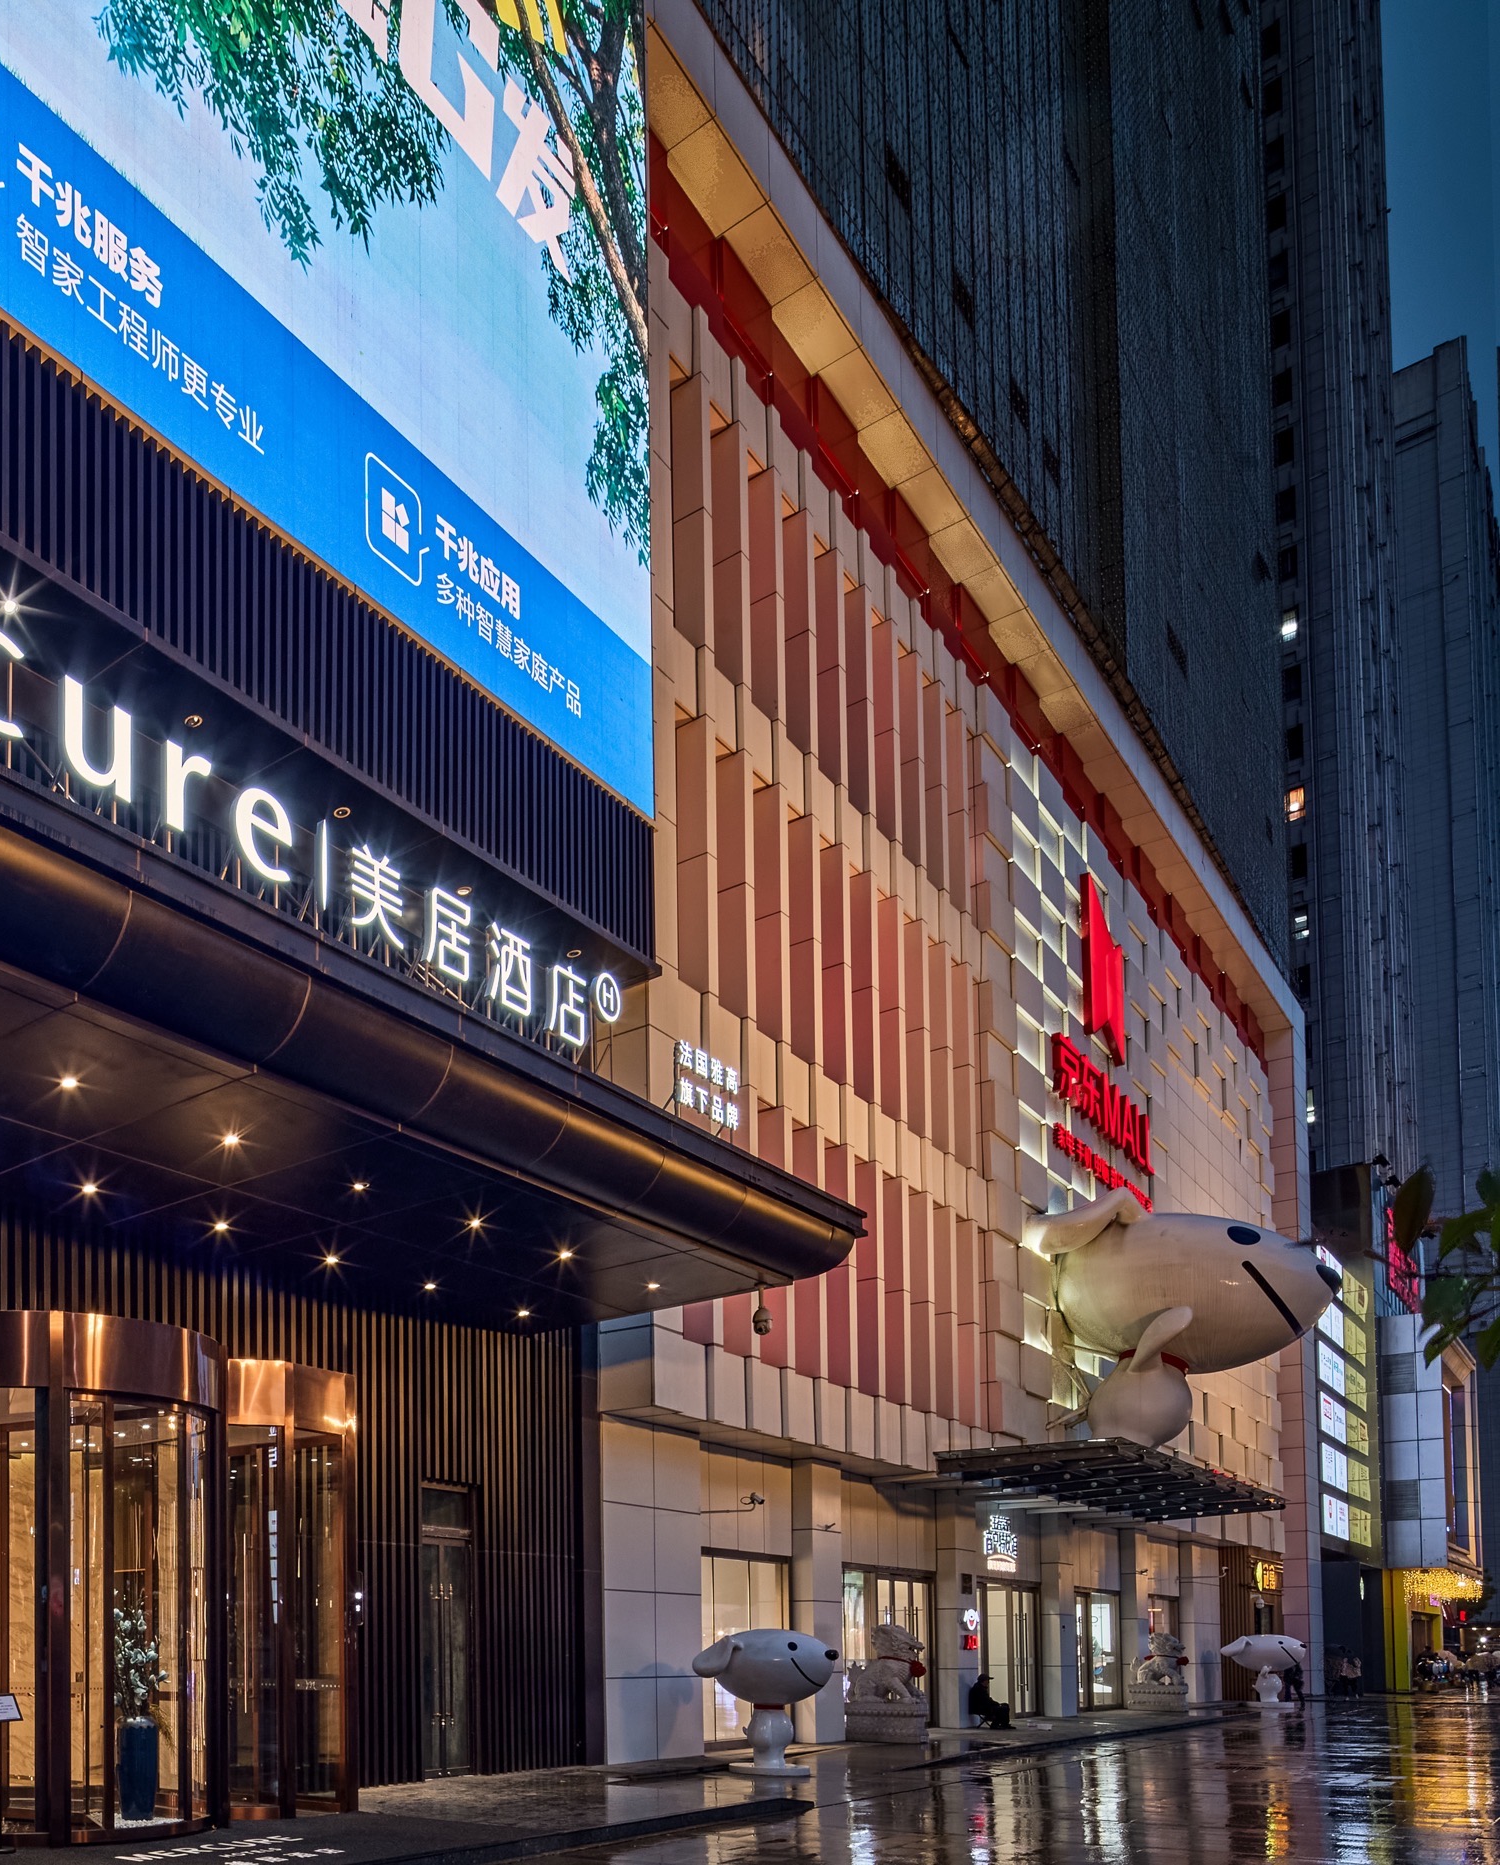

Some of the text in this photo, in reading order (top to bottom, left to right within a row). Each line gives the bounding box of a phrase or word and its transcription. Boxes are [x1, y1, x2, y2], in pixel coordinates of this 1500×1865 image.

[16, 143, 163, 309] 千兆服务
[16, 213, 266, 457] 智家工程师更专业
[435, 514, 521, 620] 千兆应用
[436, 572, 582, 719] 多种智慧家庭产品
[350, 844, 588, 1047] 美居酒店
[676, 1039, 739, 1096] 法国雅高
[678, 1077, 740, 1132] 旗下品牌
[115, 1835, 304, 1862] MERCURE
